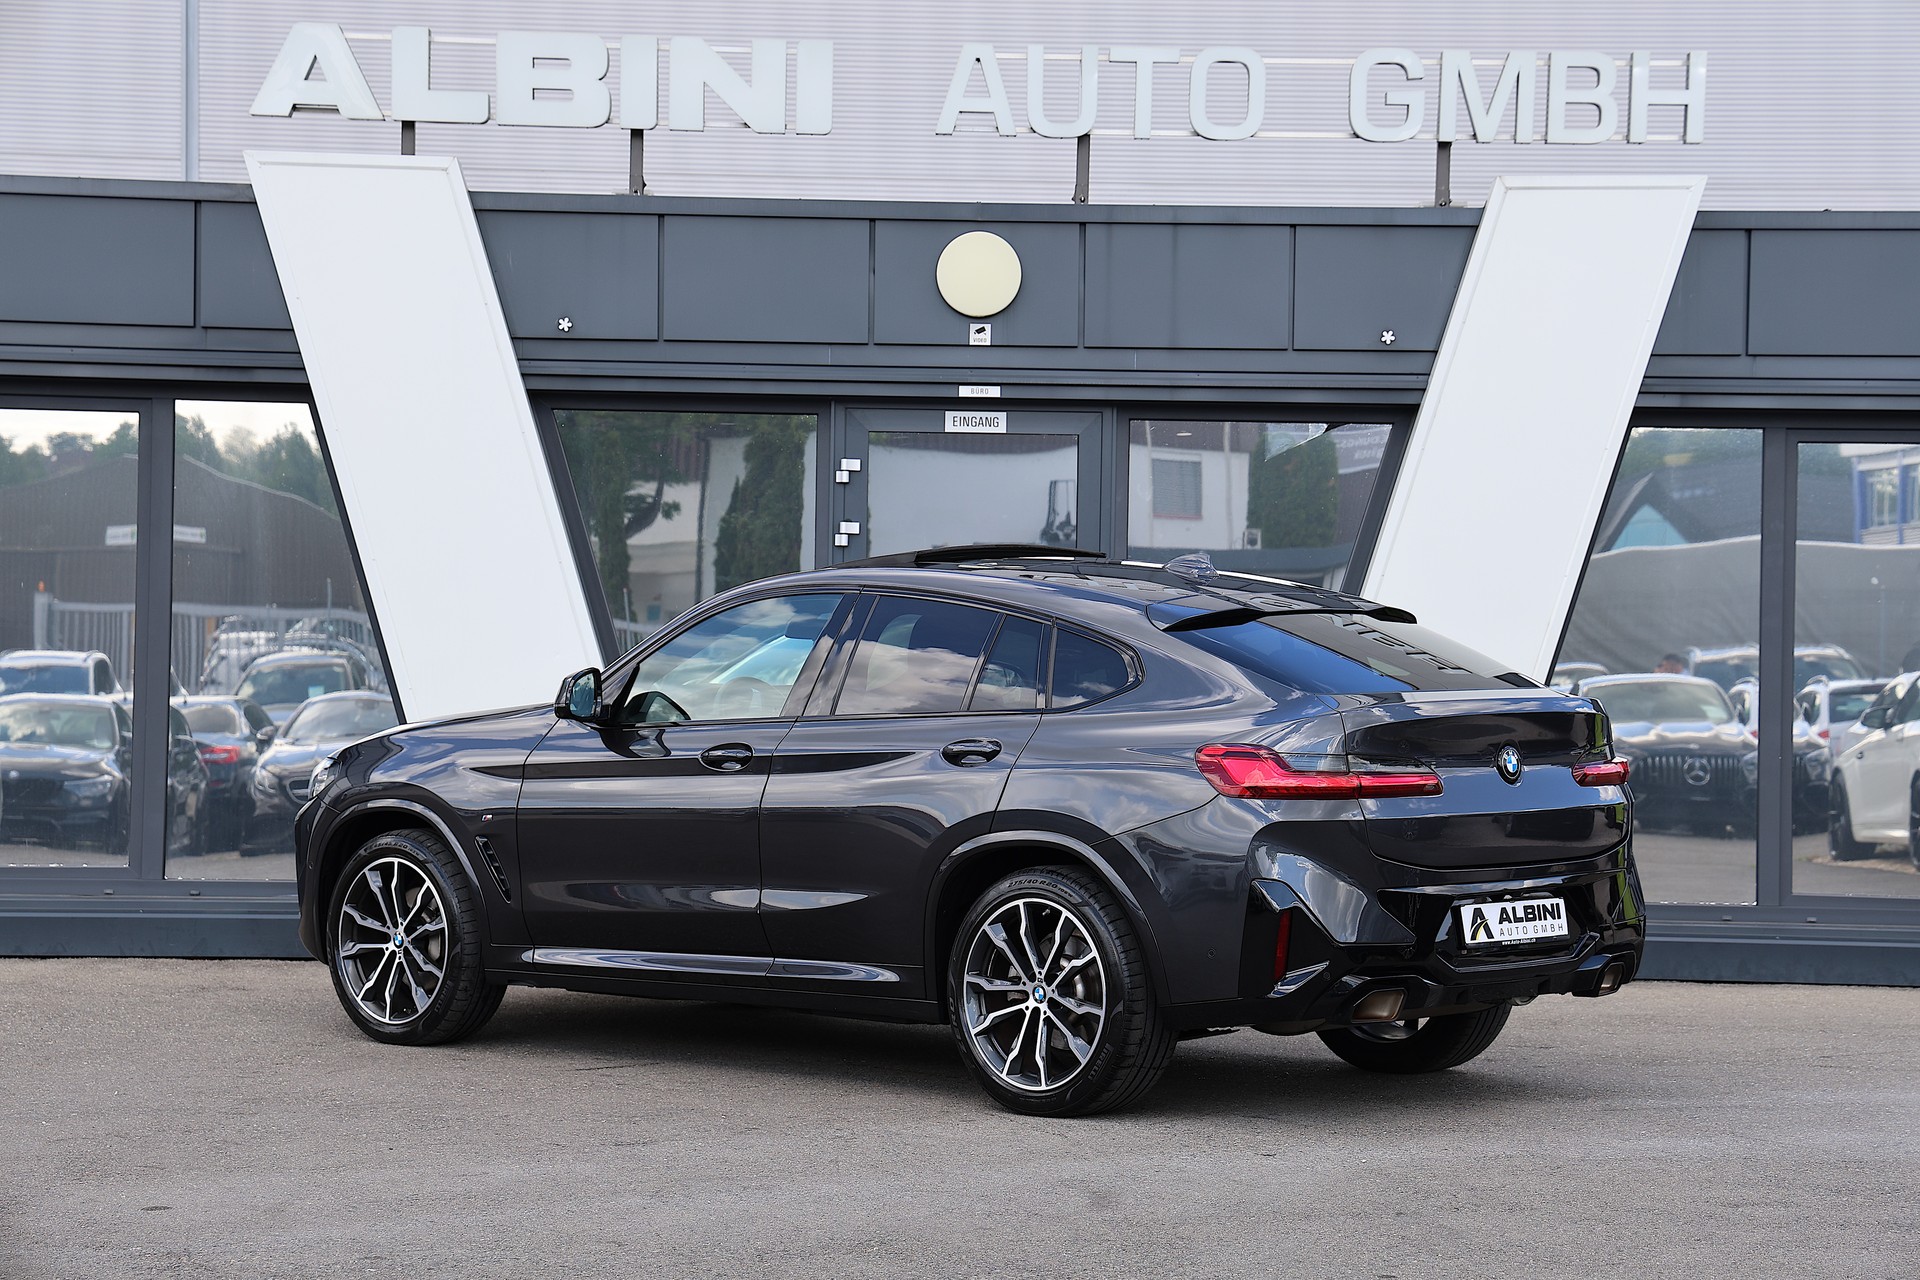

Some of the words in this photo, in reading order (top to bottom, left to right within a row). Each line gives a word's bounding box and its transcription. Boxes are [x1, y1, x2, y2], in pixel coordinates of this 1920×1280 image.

[249, 22, 834, 136] ALBINI
[935, 43, 1267, 141] AUTO
[1348, 47, 1708, 145] GMBH
[970, 387, 989, 395] BÜRO
[952, 415, 1000, 428] EINGANG
[1007, 879, 1038, 888] 275/40
[1039, 880, 1058, 889] R20
[1499, 902, 1562, 924] ALBINI
[1500, 925, 1528, 937] AUTO
[1533, 923, 1564, 934] GMBH
